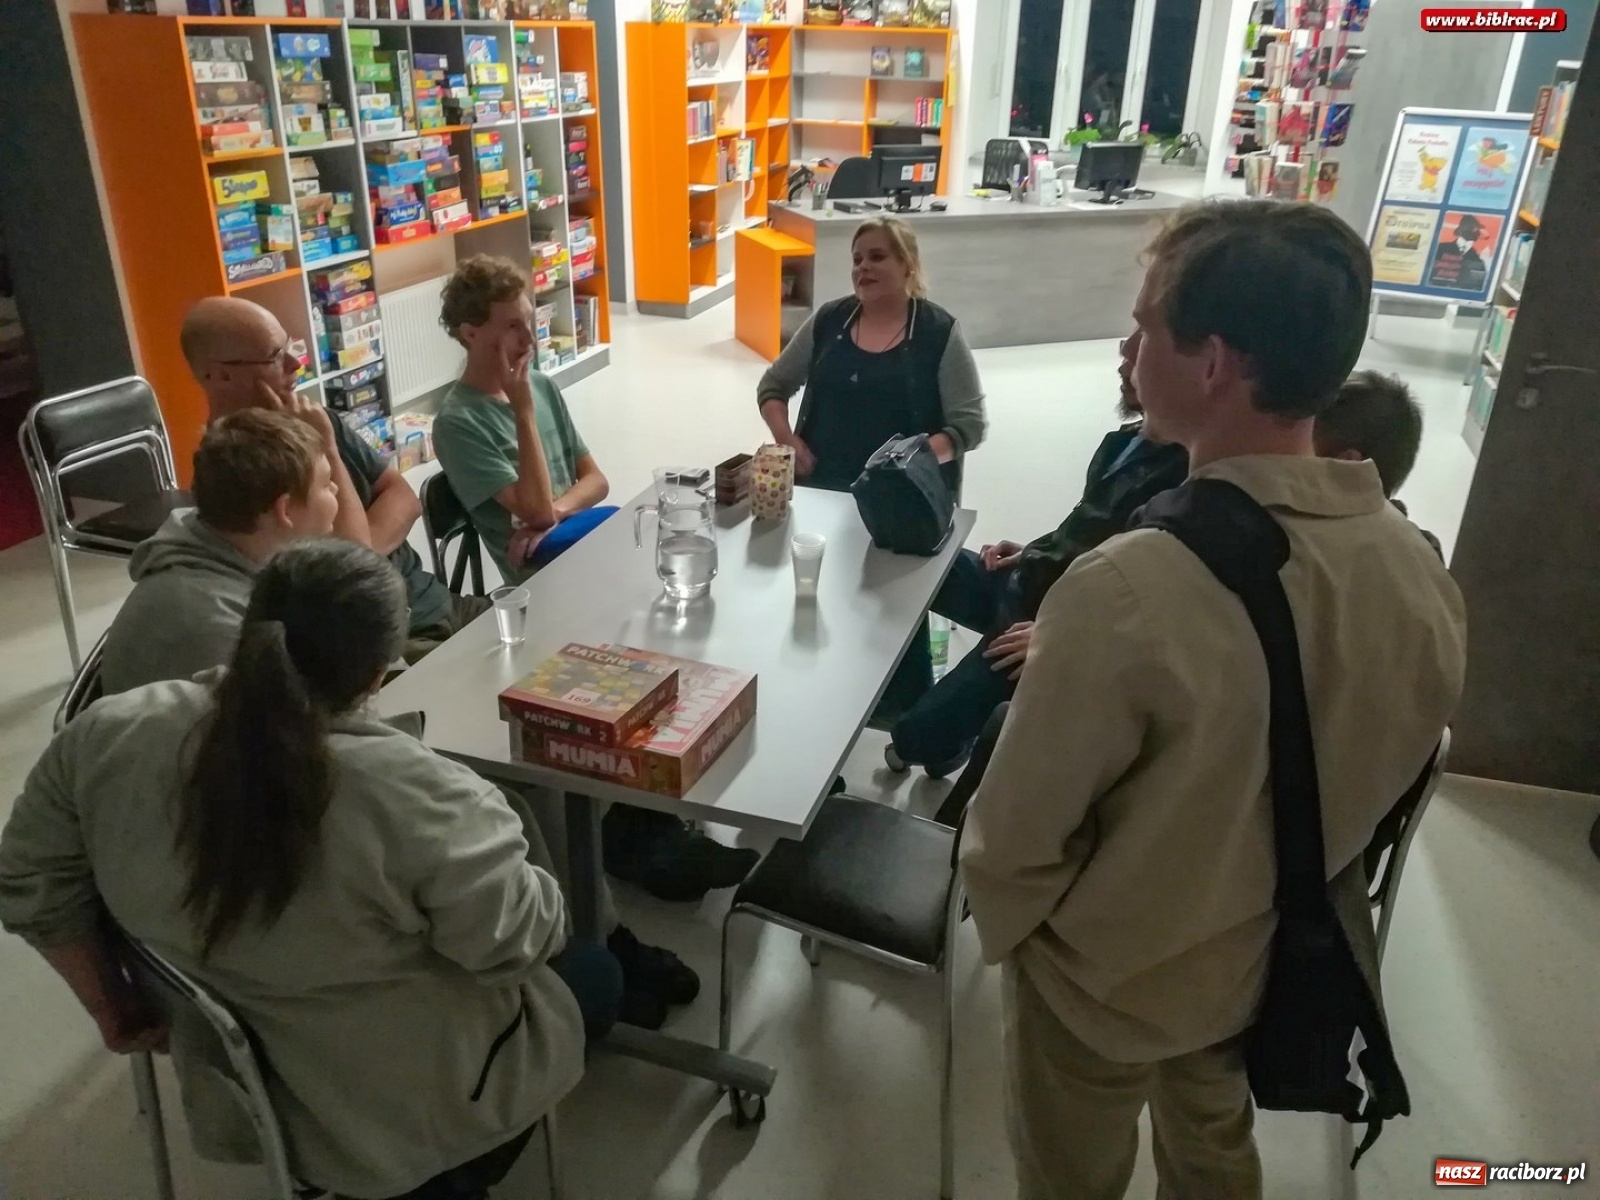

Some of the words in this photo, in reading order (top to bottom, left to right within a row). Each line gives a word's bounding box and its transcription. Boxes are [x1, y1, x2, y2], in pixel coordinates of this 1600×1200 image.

[567, 693, 592, 705] 169
[599, 730, 608, 742] 2
[701, 707, 741, 767] MUMIA
[548, 739, 637, 779] MUMIA
